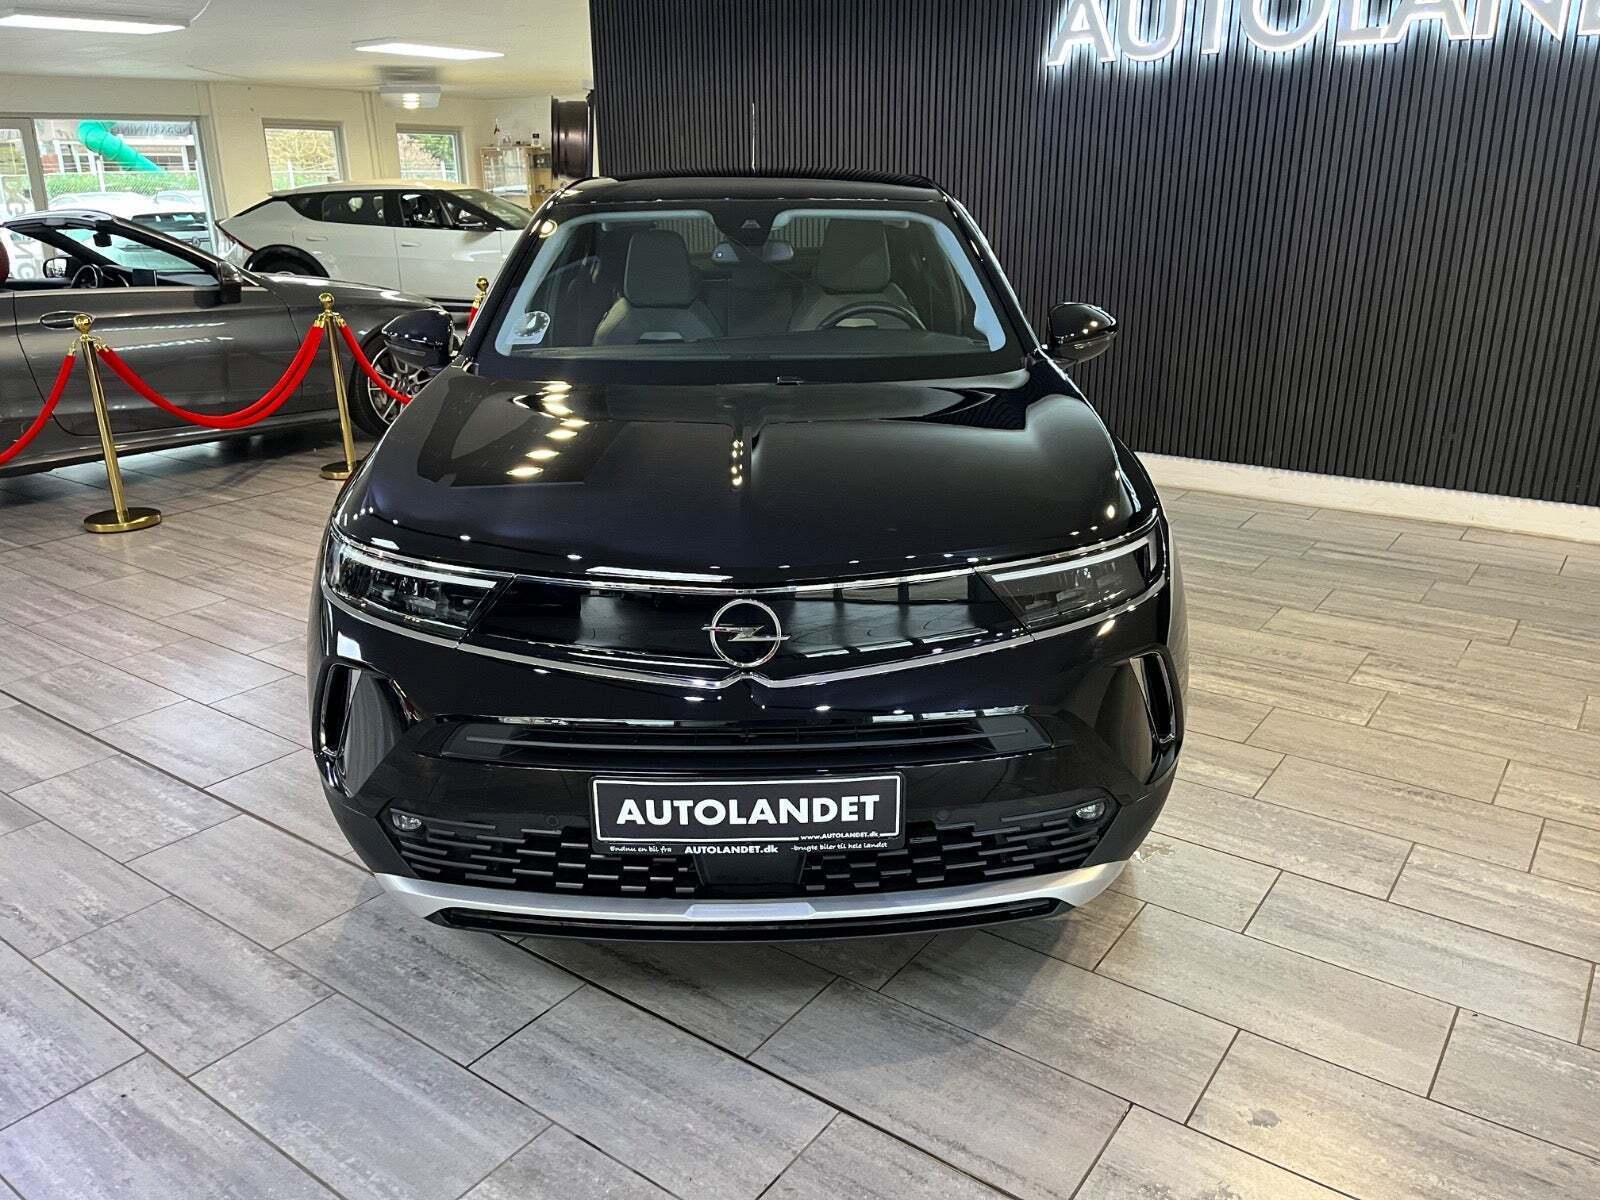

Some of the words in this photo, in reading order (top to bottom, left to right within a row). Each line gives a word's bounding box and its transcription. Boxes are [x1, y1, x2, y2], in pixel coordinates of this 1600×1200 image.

[1046, 0, 1600, 66] AUOLAN
[616, 794, 880, 826] AUTOLANDET
[800, 831, 879, 841] www.AUTOLANDET.dk
[660, 845, 672, 854] fra
[684, 844, 779, 855] AUTOLANDET.dk
